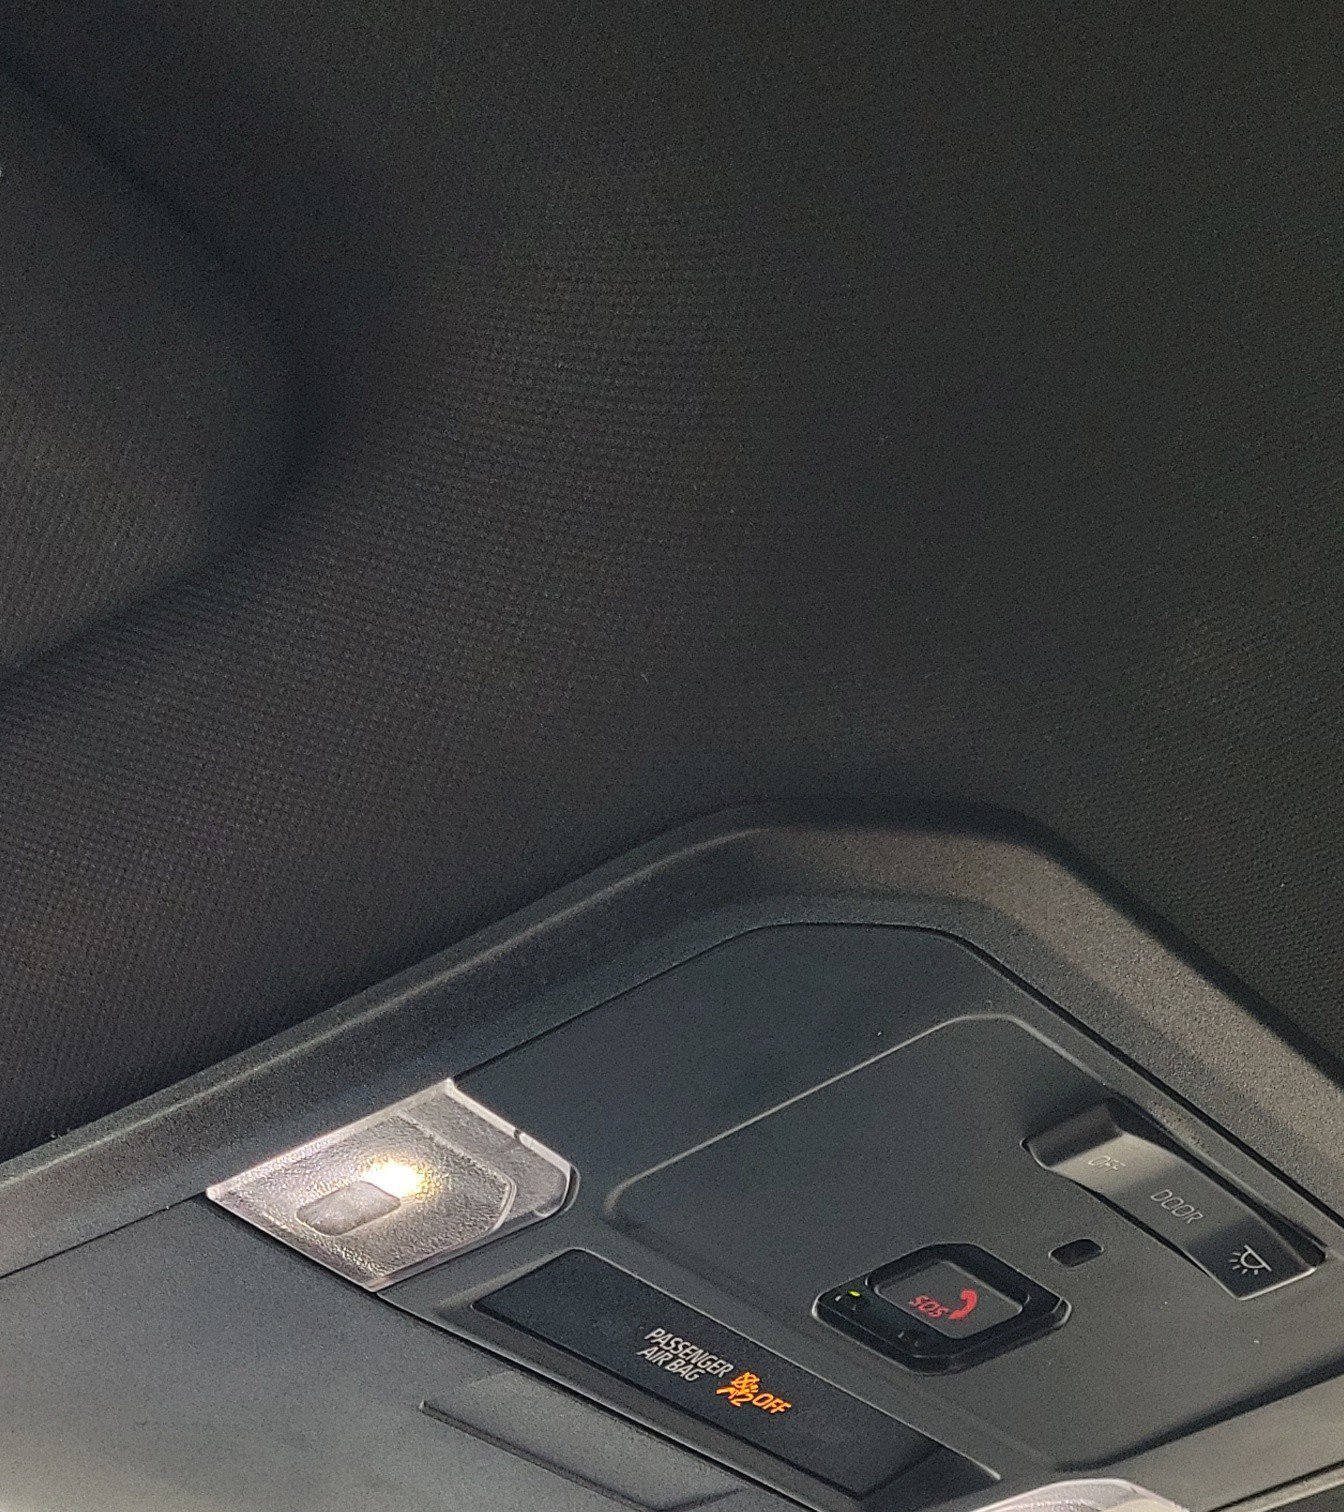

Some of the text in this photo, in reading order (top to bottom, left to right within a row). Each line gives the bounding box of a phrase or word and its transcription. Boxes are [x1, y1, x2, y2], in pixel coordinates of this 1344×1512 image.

[1150, 1188, 1203, 1224] DOOR
[909, 1294, 950, 1318] SOS
[636, 1345, 706, 1382] AIR BAG
[643, 1327, 734, 1378] PASSENGER
[752, 1393, 792, 1414] OFF
